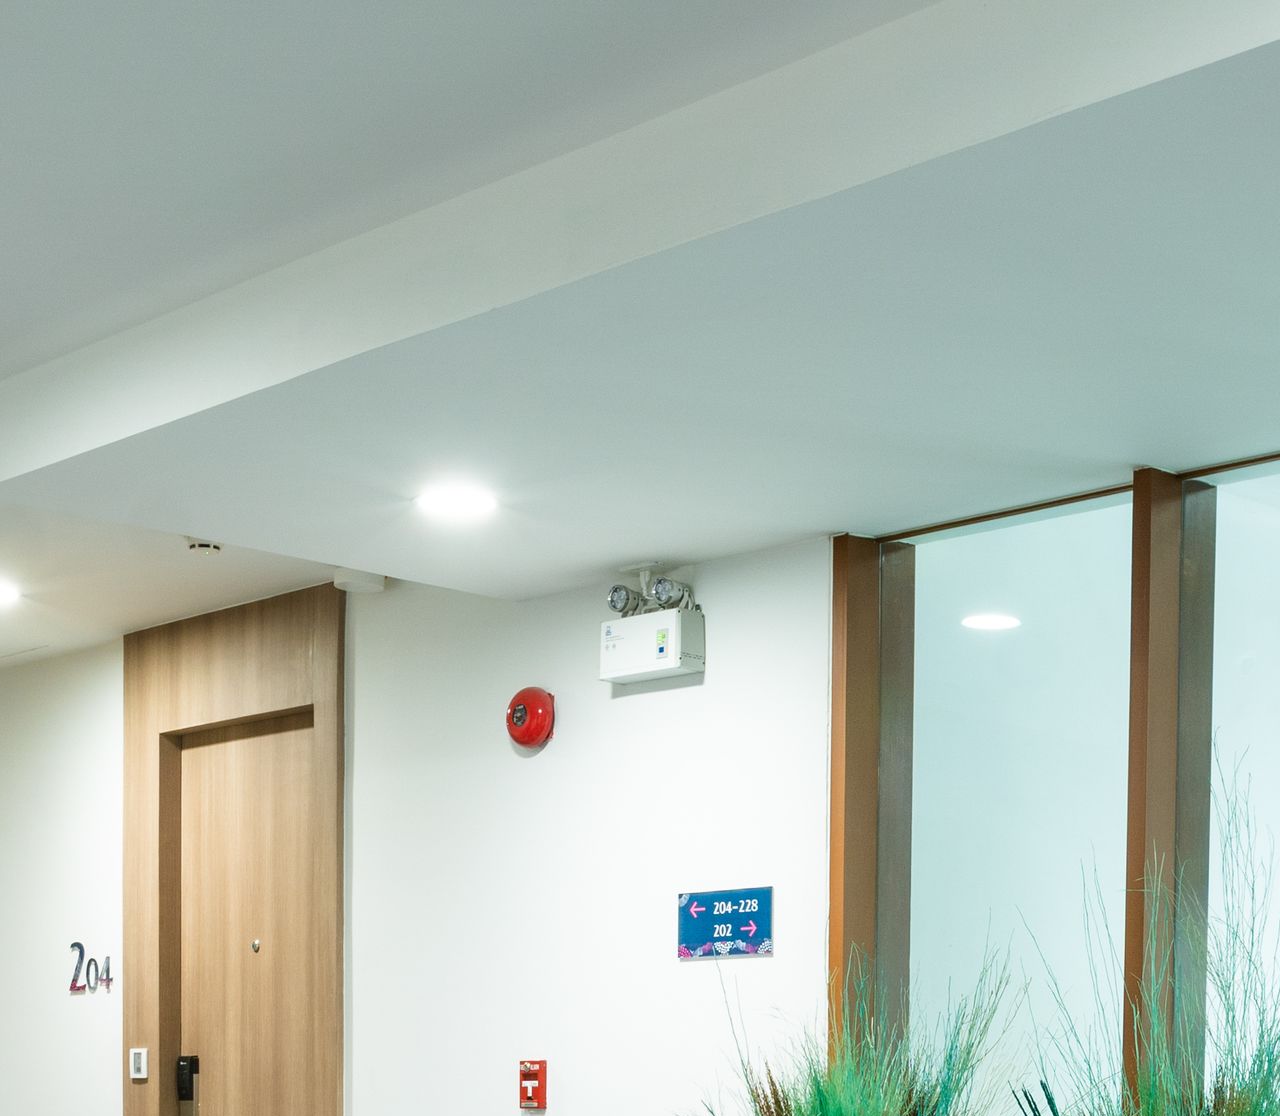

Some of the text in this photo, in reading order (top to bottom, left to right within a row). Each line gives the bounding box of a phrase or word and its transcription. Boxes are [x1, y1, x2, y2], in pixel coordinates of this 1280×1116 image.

[713, 898, 759, 915] 204-228
[713, 924, 733, 938] 202
[69, 941, 113, 994] 204
